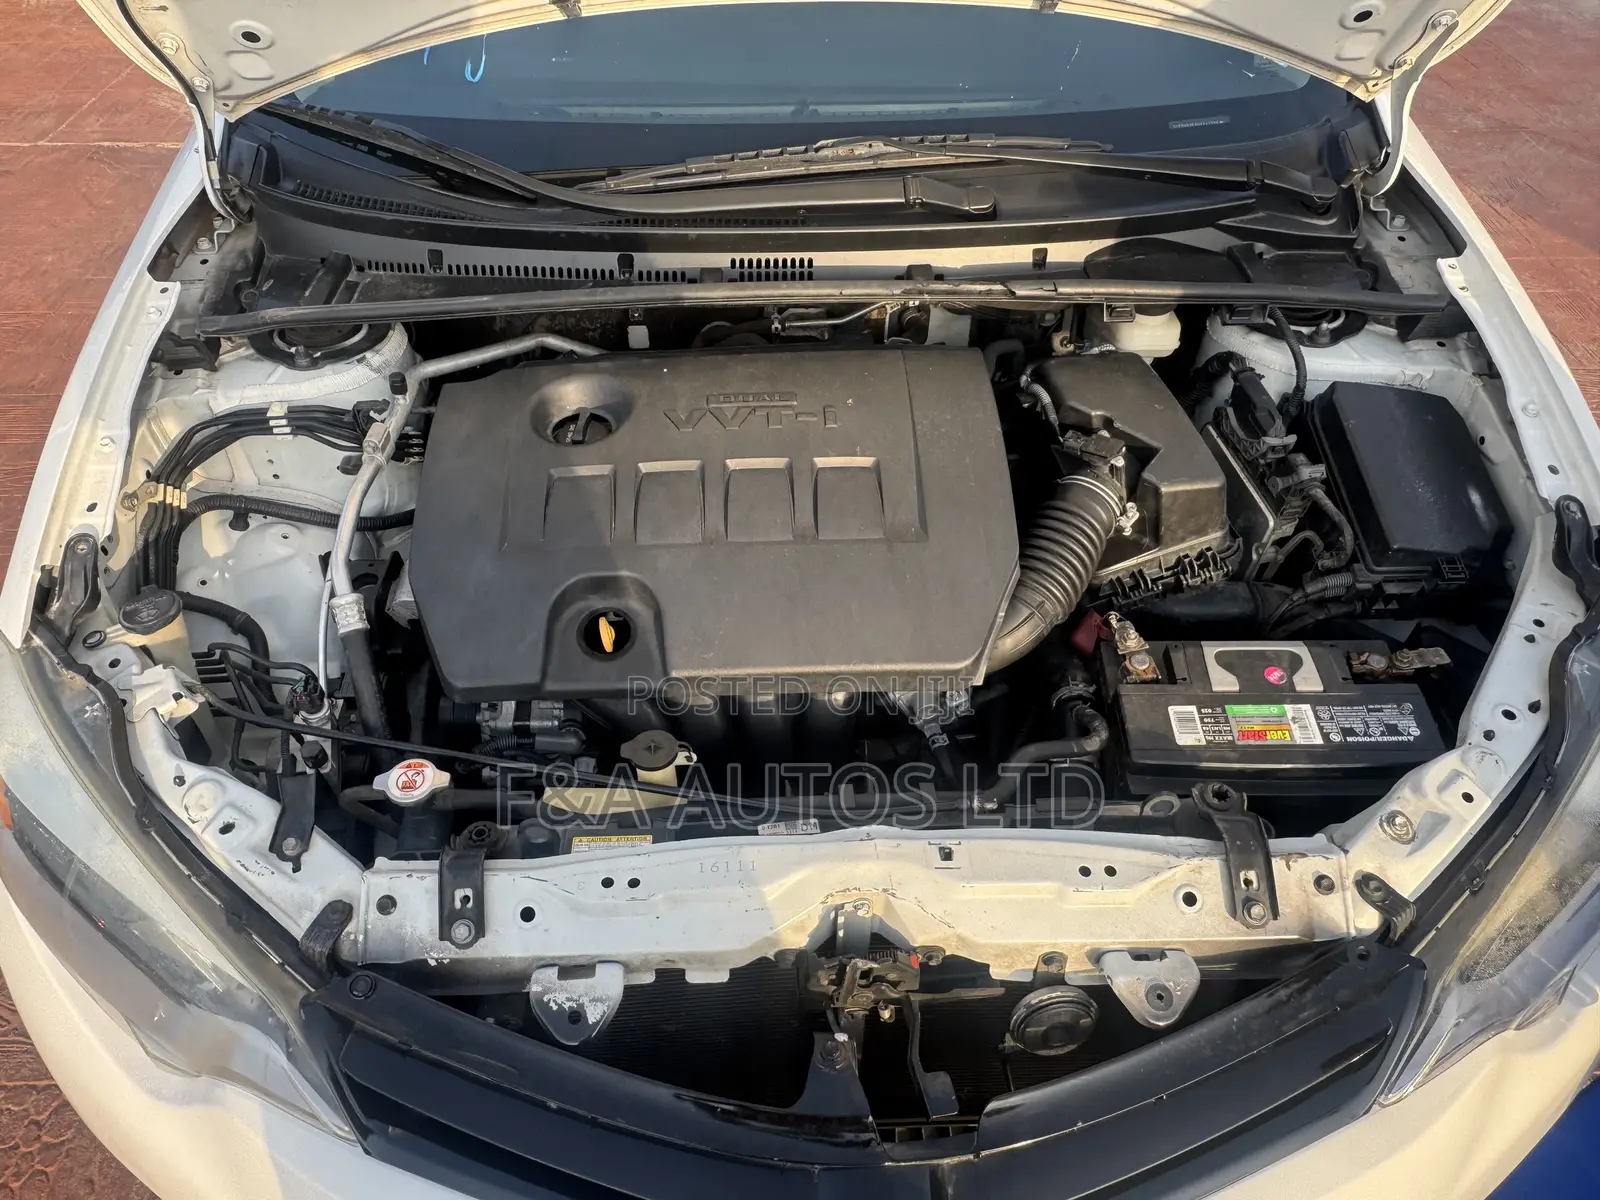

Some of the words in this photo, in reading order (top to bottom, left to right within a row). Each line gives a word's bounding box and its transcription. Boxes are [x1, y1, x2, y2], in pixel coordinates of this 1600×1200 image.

[719, 394, 785, 403] DUAL
[1237, 729, 1292, 742] EverStart
[699, 860, 757, 874] 16111
